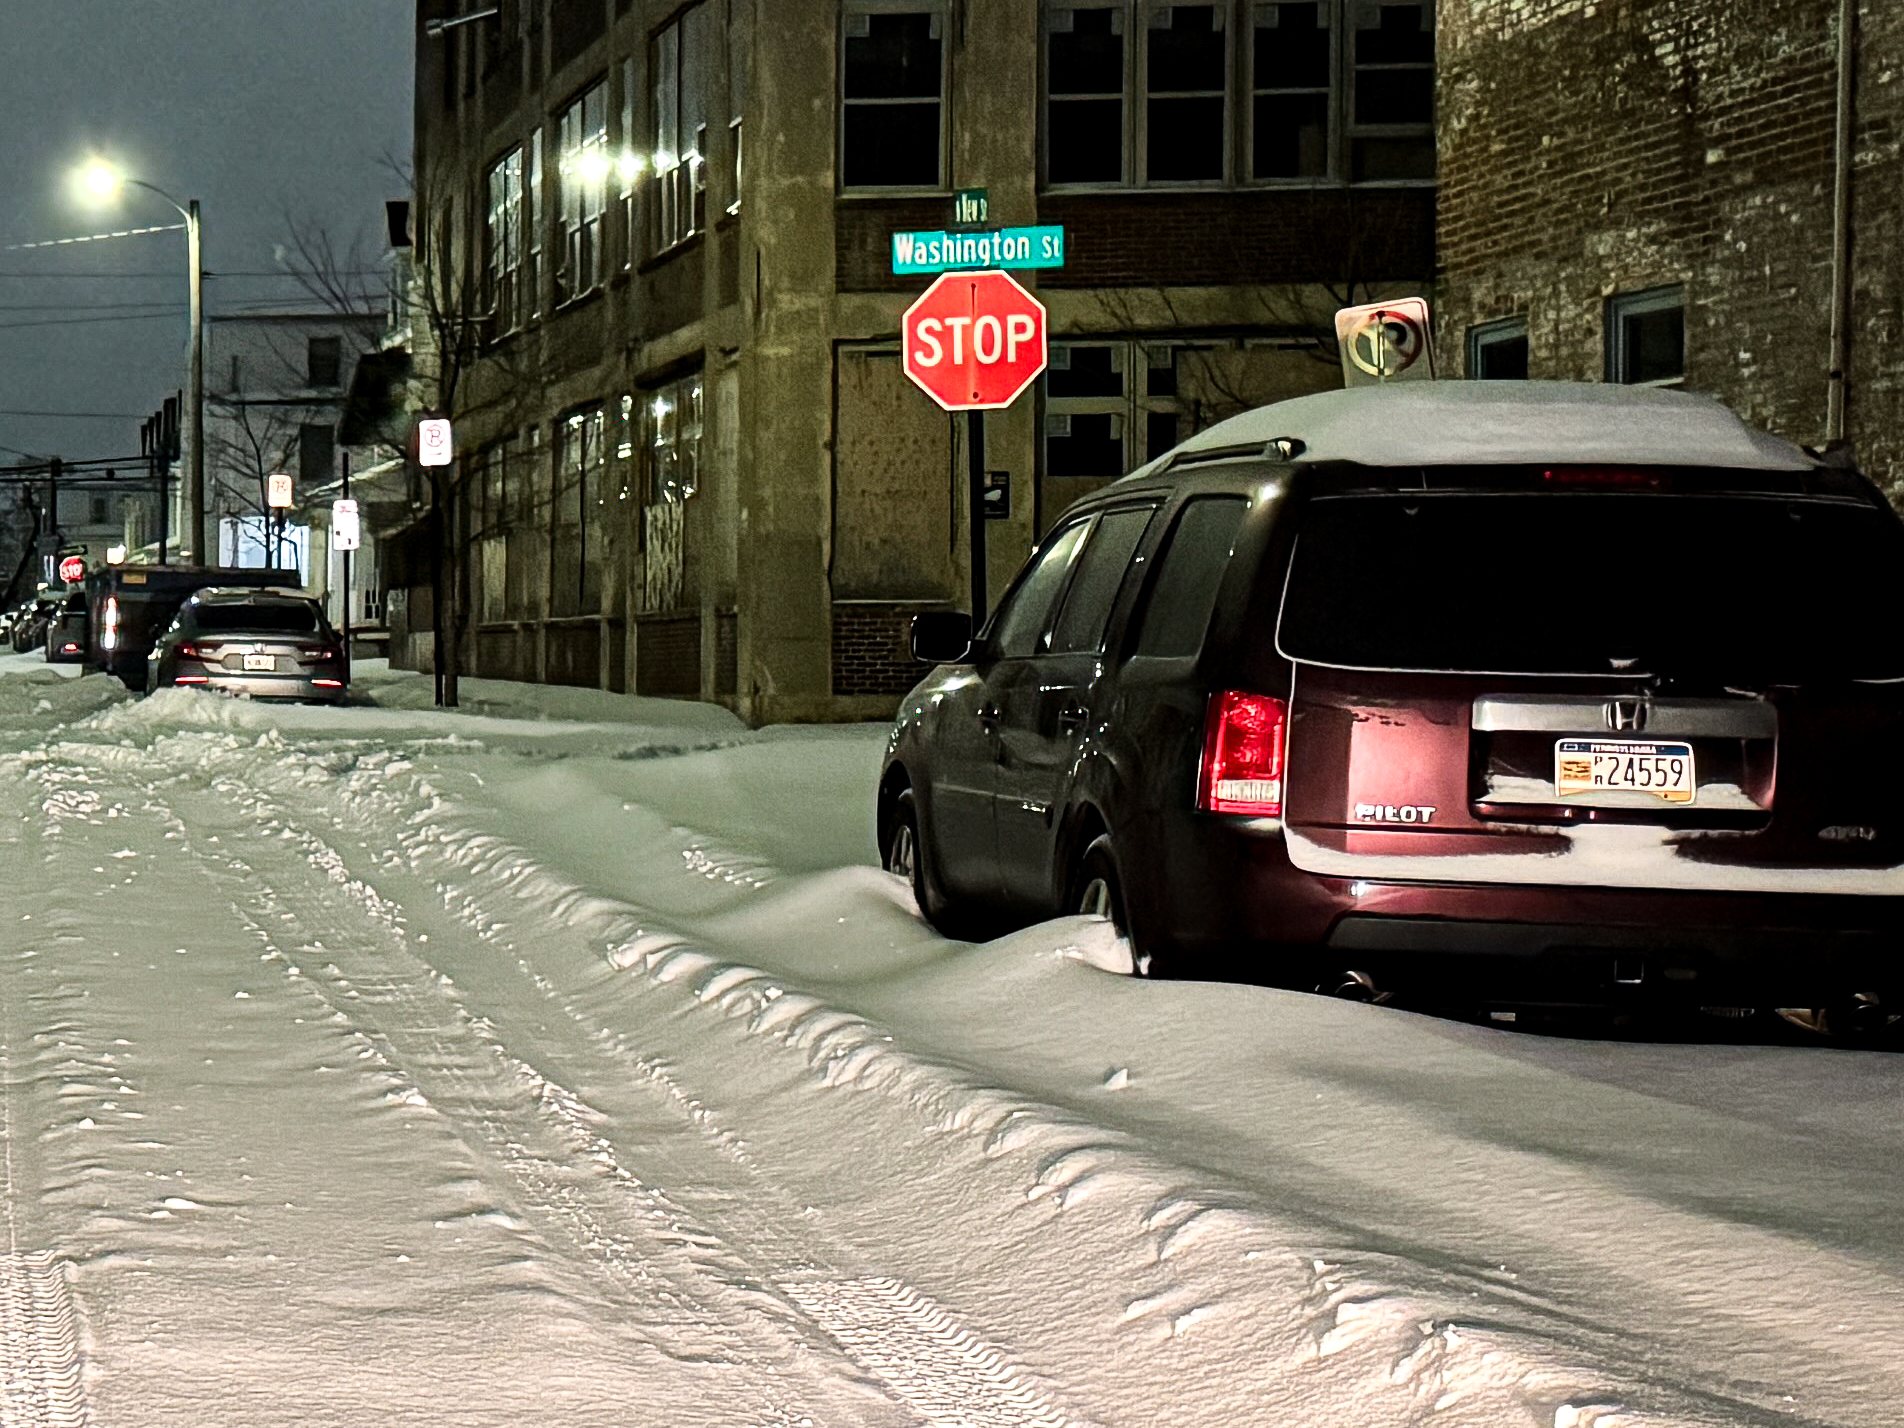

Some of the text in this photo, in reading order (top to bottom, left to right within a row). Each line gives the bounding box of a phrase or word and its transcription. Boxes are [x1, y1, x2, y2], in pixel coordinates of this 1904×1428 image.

[894, 232, 1061, 266] Washington St
[914, 314, 1035, 367] STOP
[1608, 756, 1683, 787] 24559
[1355, 803, 1436, 823] PILOT
